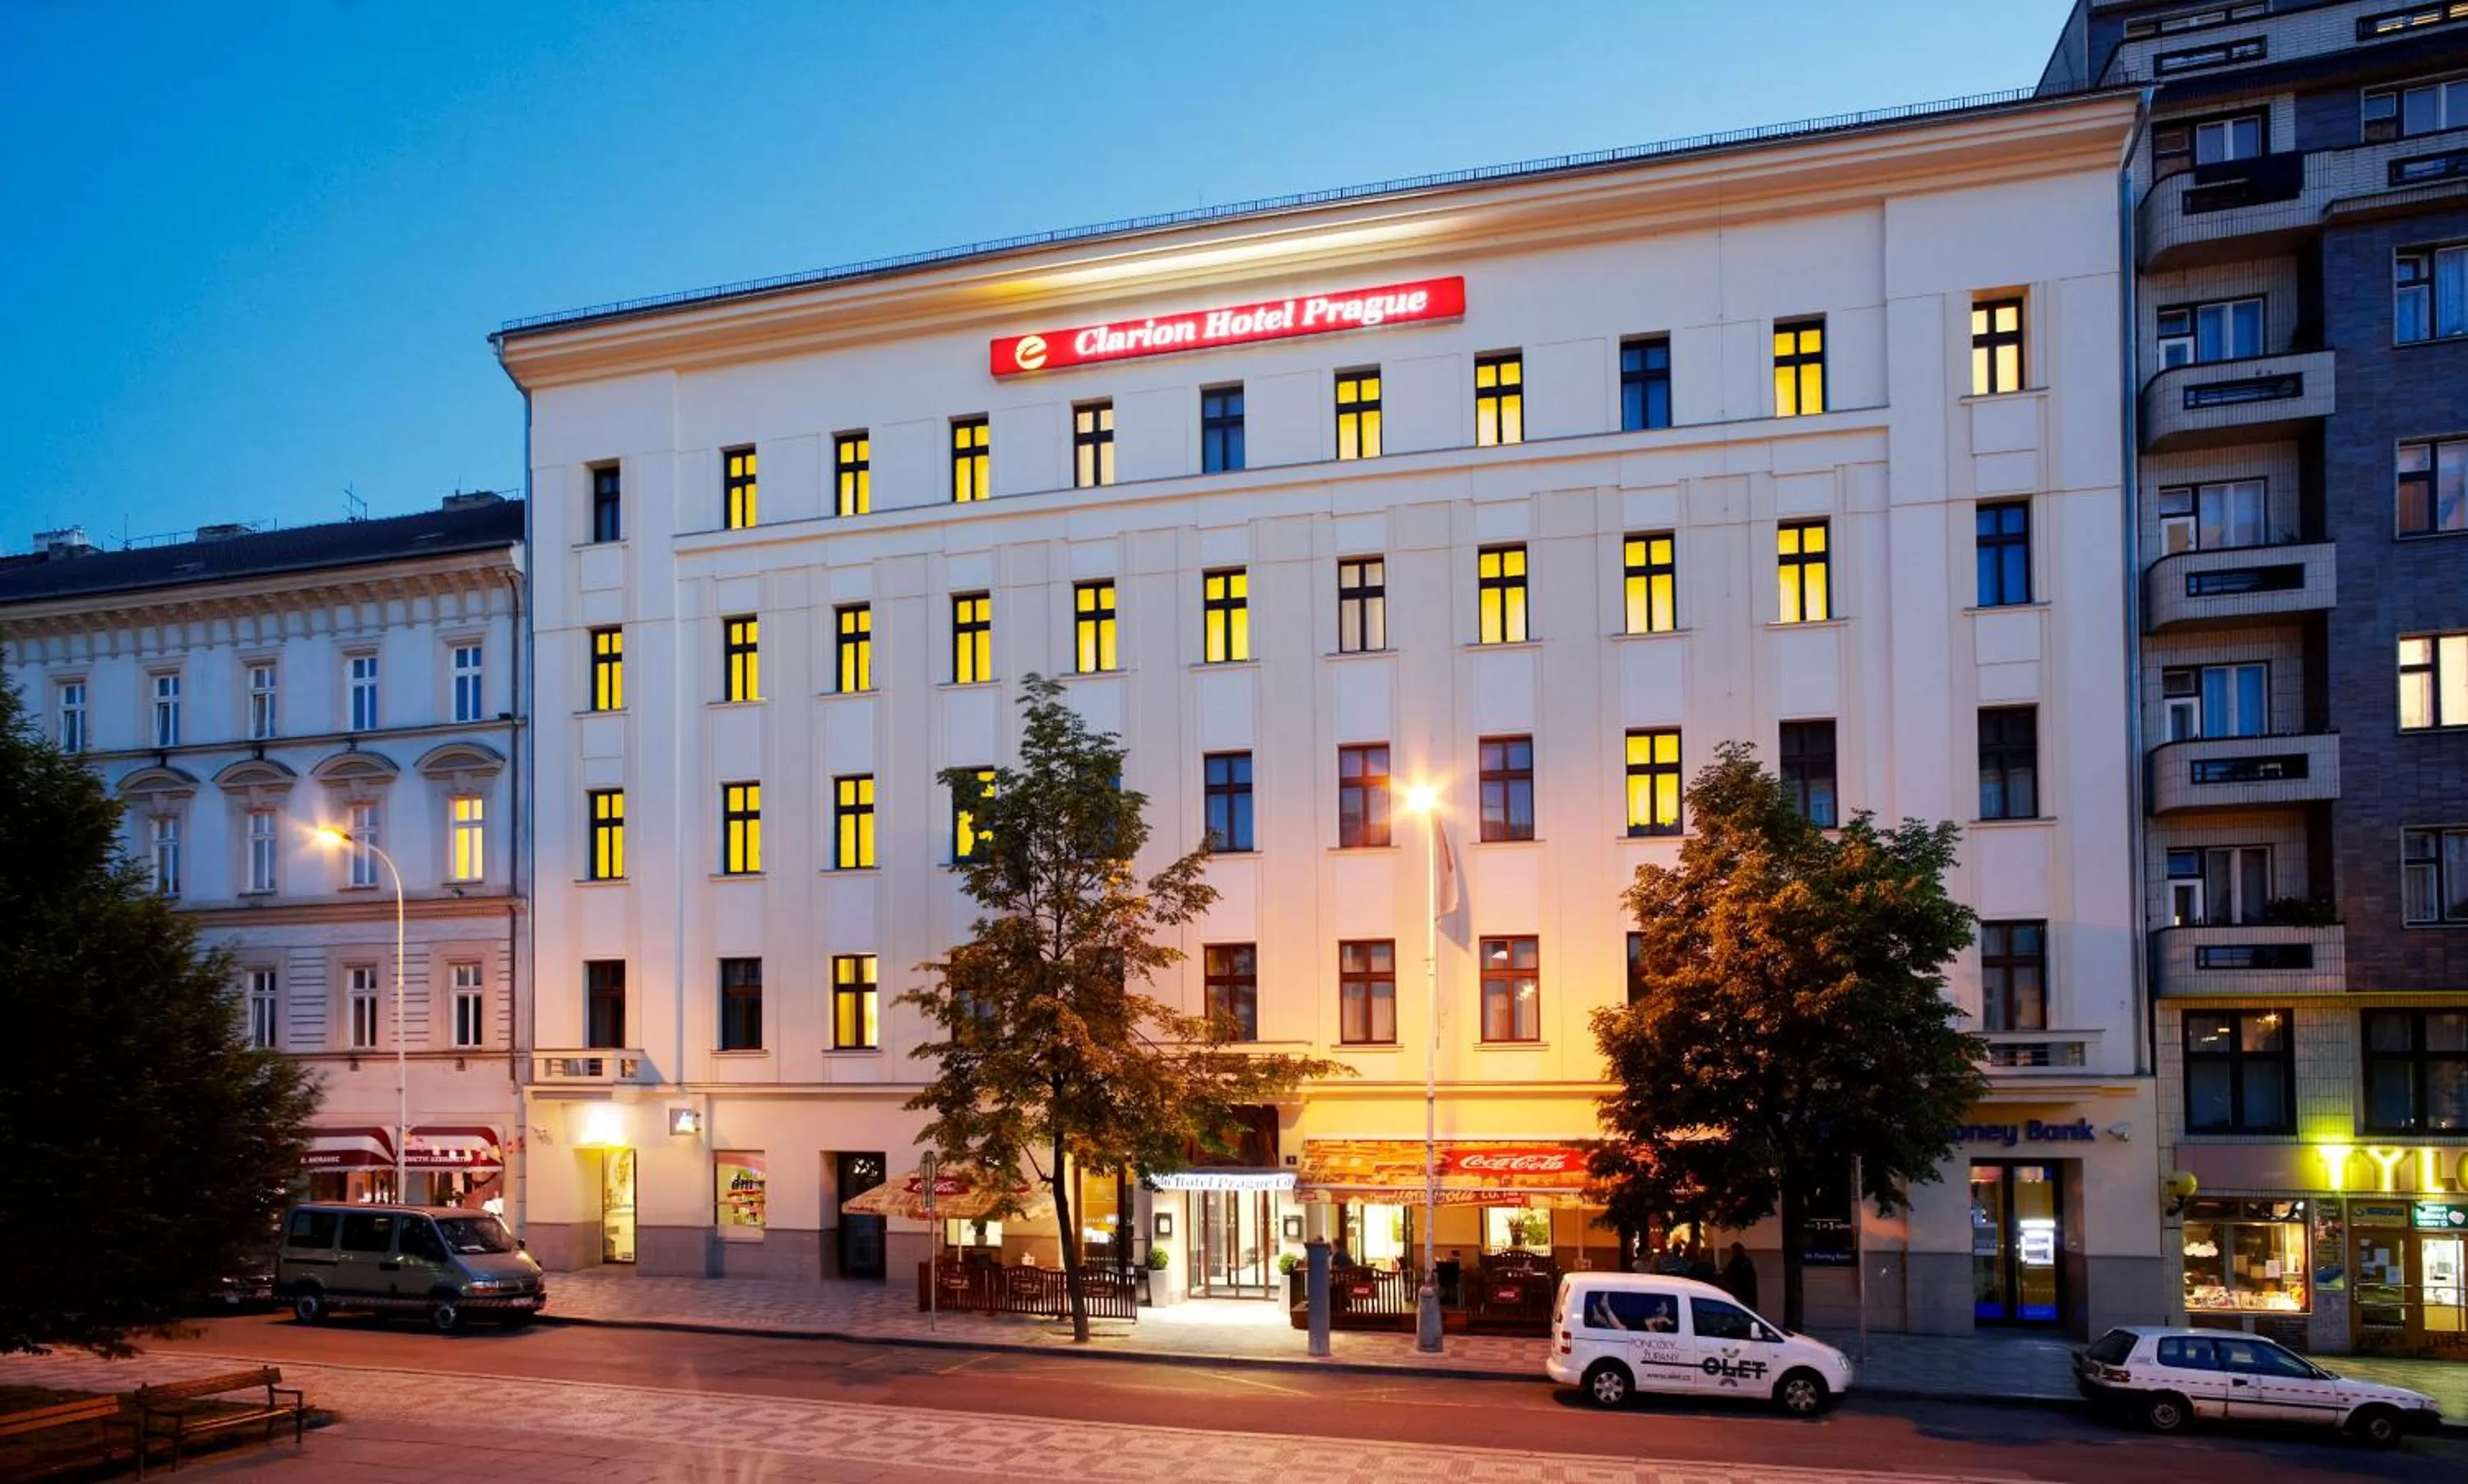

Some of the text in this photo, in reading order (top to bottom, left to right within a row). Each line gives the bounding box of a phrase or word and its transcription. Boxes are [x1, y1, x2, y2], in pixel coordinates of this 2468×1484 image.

[1074, 289, 1427, 356] Clarion Hotel Prague
[1946, 1118, 2095, 1147] oney Bank
[2317, 1145, 2468, 1191] TYL
[1702, 1356, 1768, 1380] OLET
